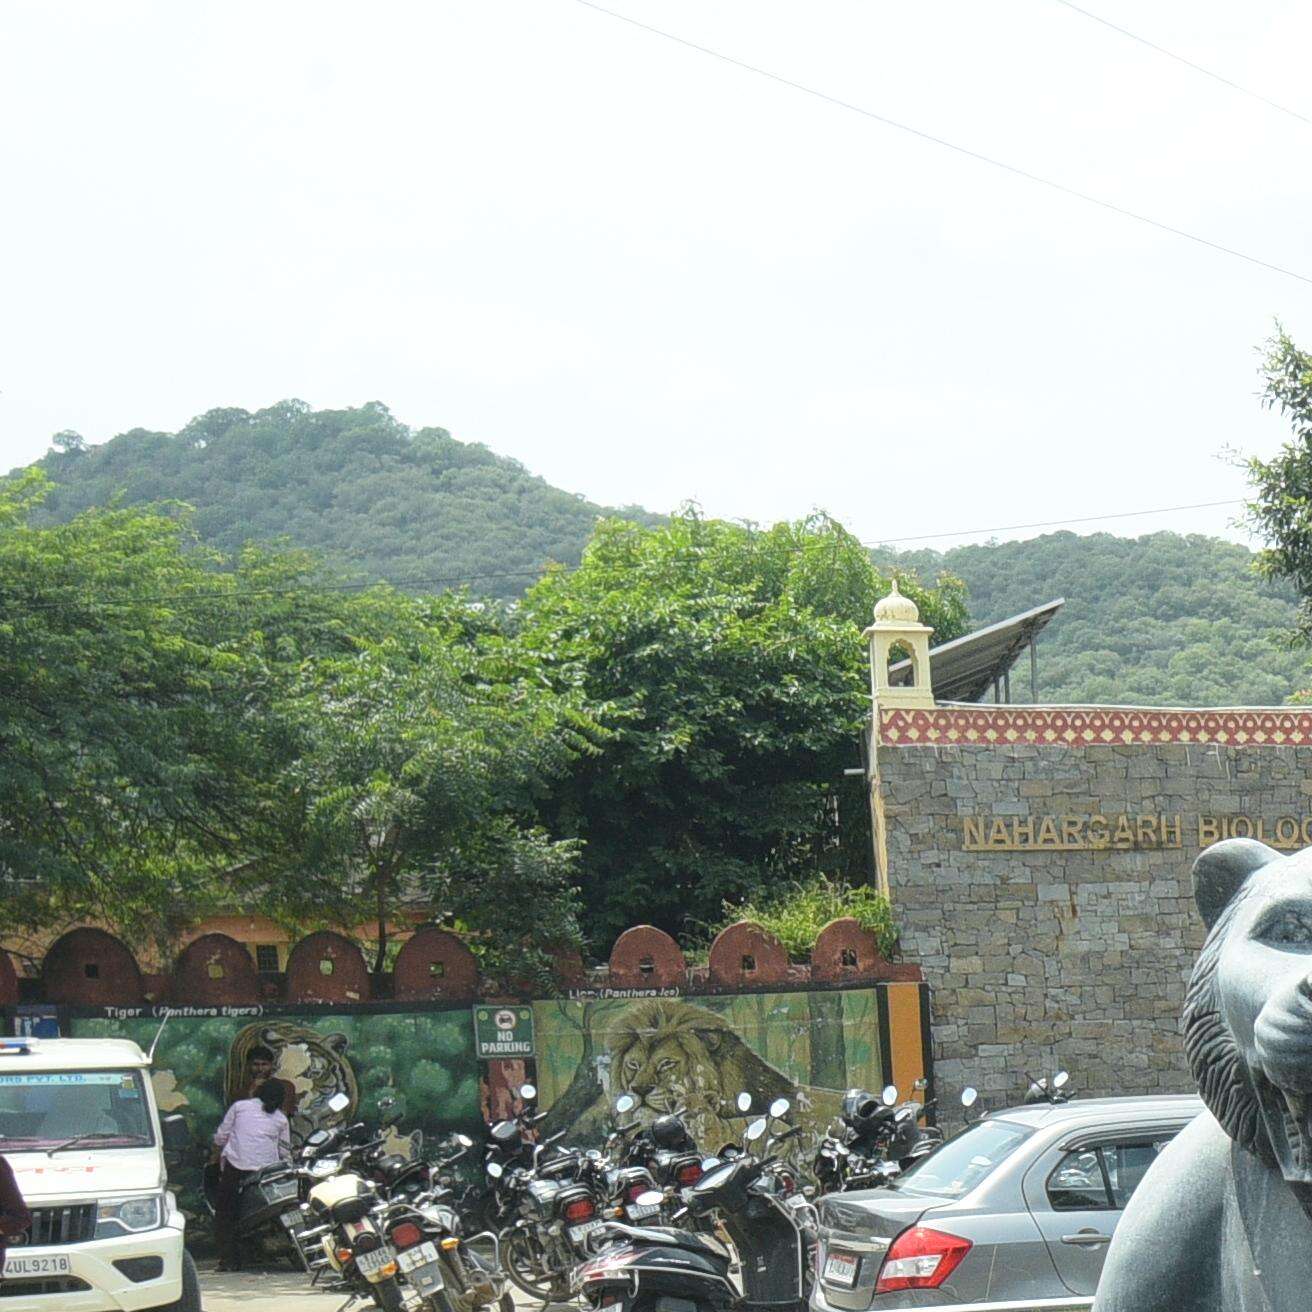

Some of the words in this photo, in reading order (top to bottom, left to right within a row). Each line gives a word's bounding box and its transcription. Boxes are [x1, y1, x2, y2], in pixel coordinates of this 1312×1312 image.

[963, 815, 1181, 849] NAHARGARH
[104, 1007, 142, 1019] Tiger
[152, 1006, 217, 1017] (Panthera
[497, 1031, 513, 1041] NO
[481, 1042, 531, 1053] PARKING
